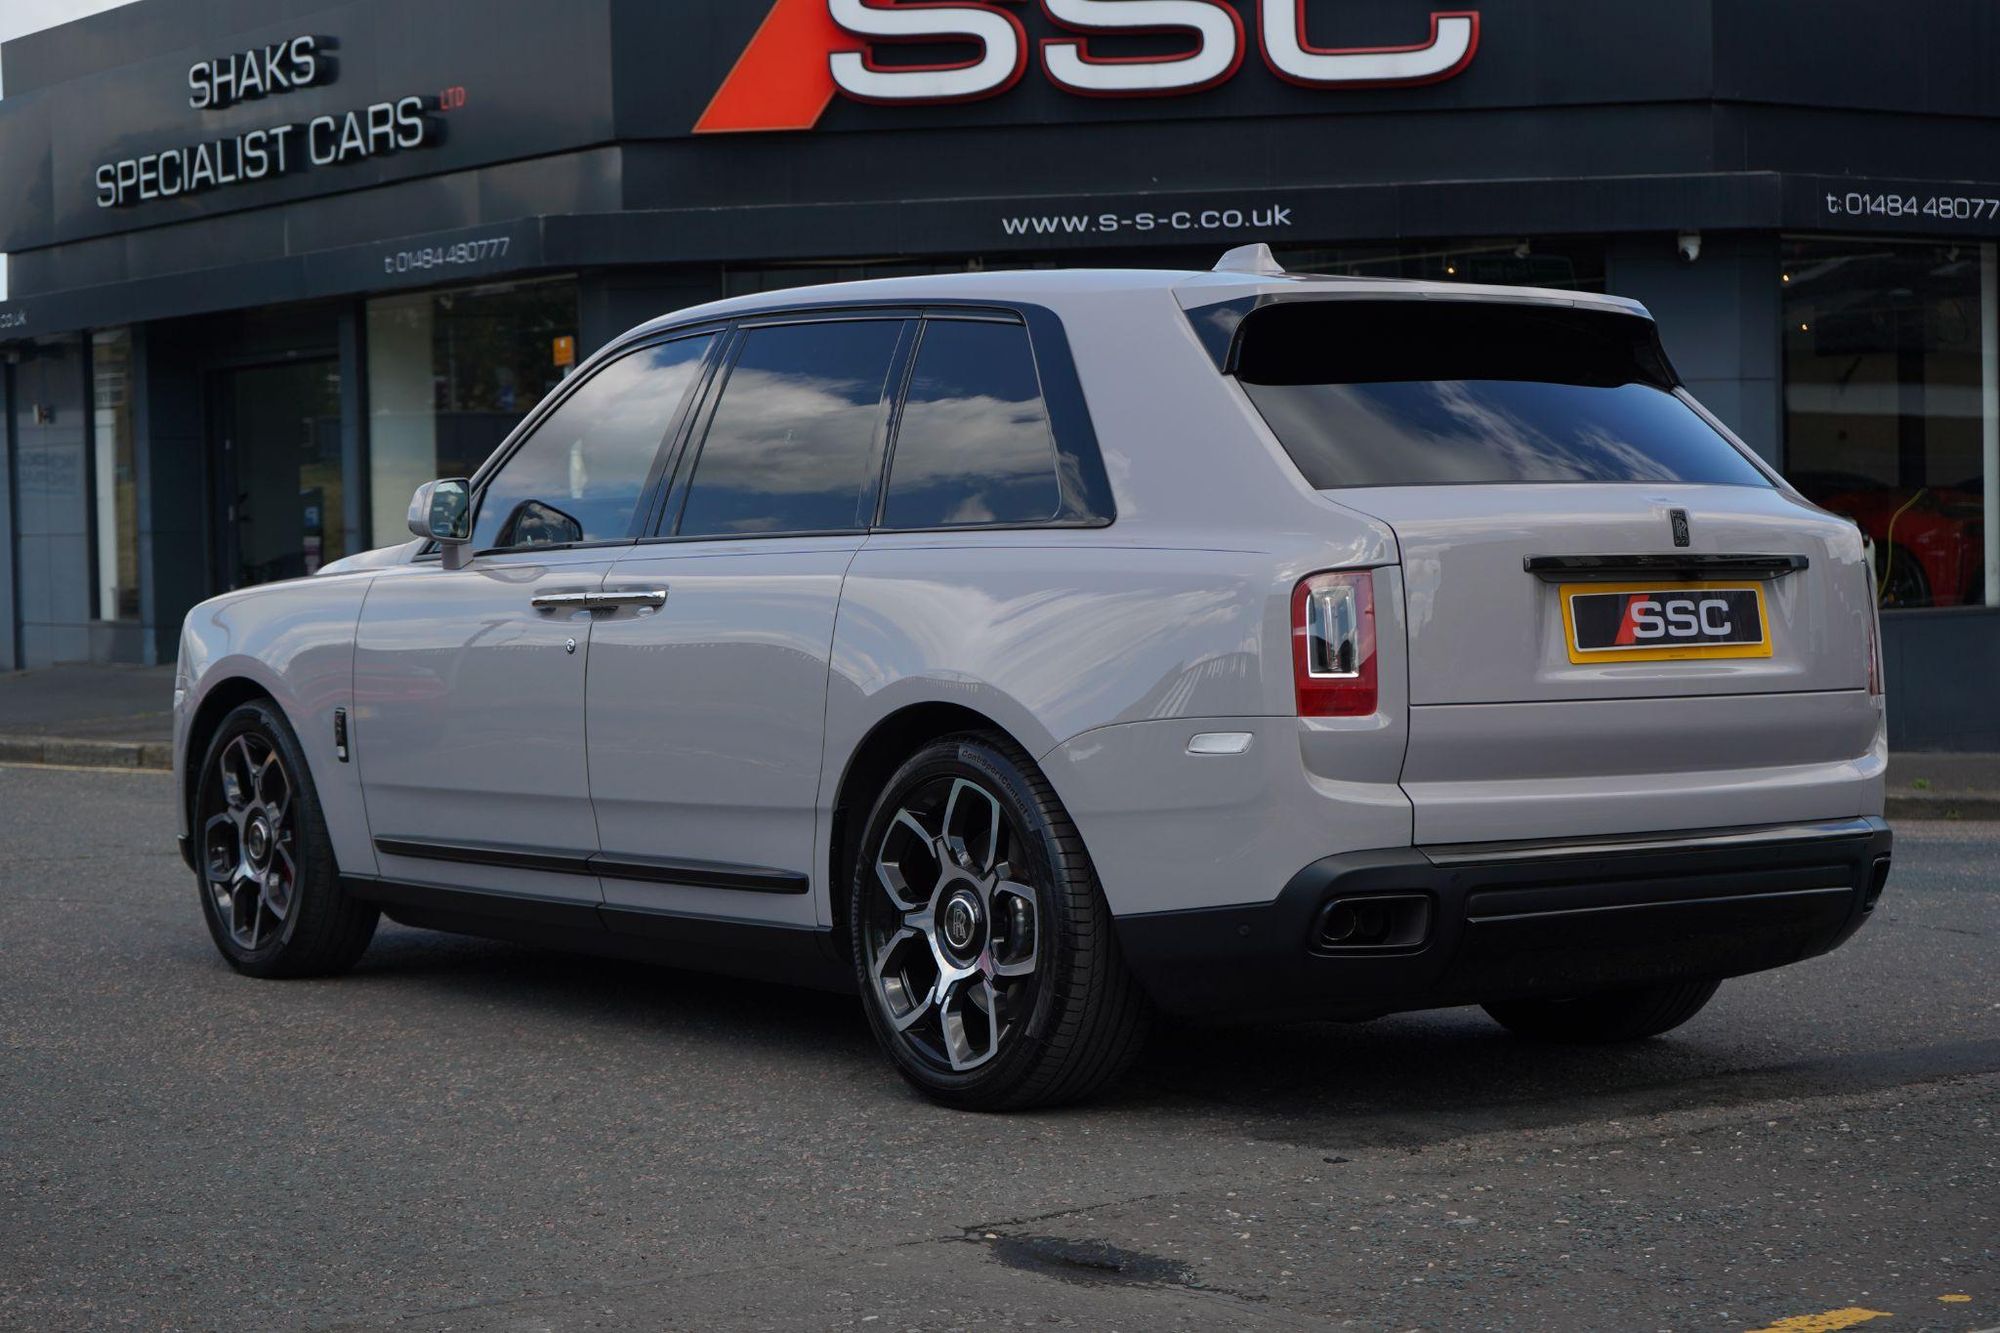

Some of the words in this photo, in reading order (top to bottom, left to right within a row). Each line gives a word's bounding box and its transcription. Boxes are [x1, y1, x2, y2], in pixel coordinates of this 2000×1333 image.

[188, 36, 316, 108] SHAKS
[96, 125, 292, 208] SPECIALIST
[308, 96, 424, 165] CARS
[440, 86, 466, 110] LTD
[1002, 204, 1292, 235] www.s-s-c.co.uk
[1631, 600, 1731, 638] SSC
